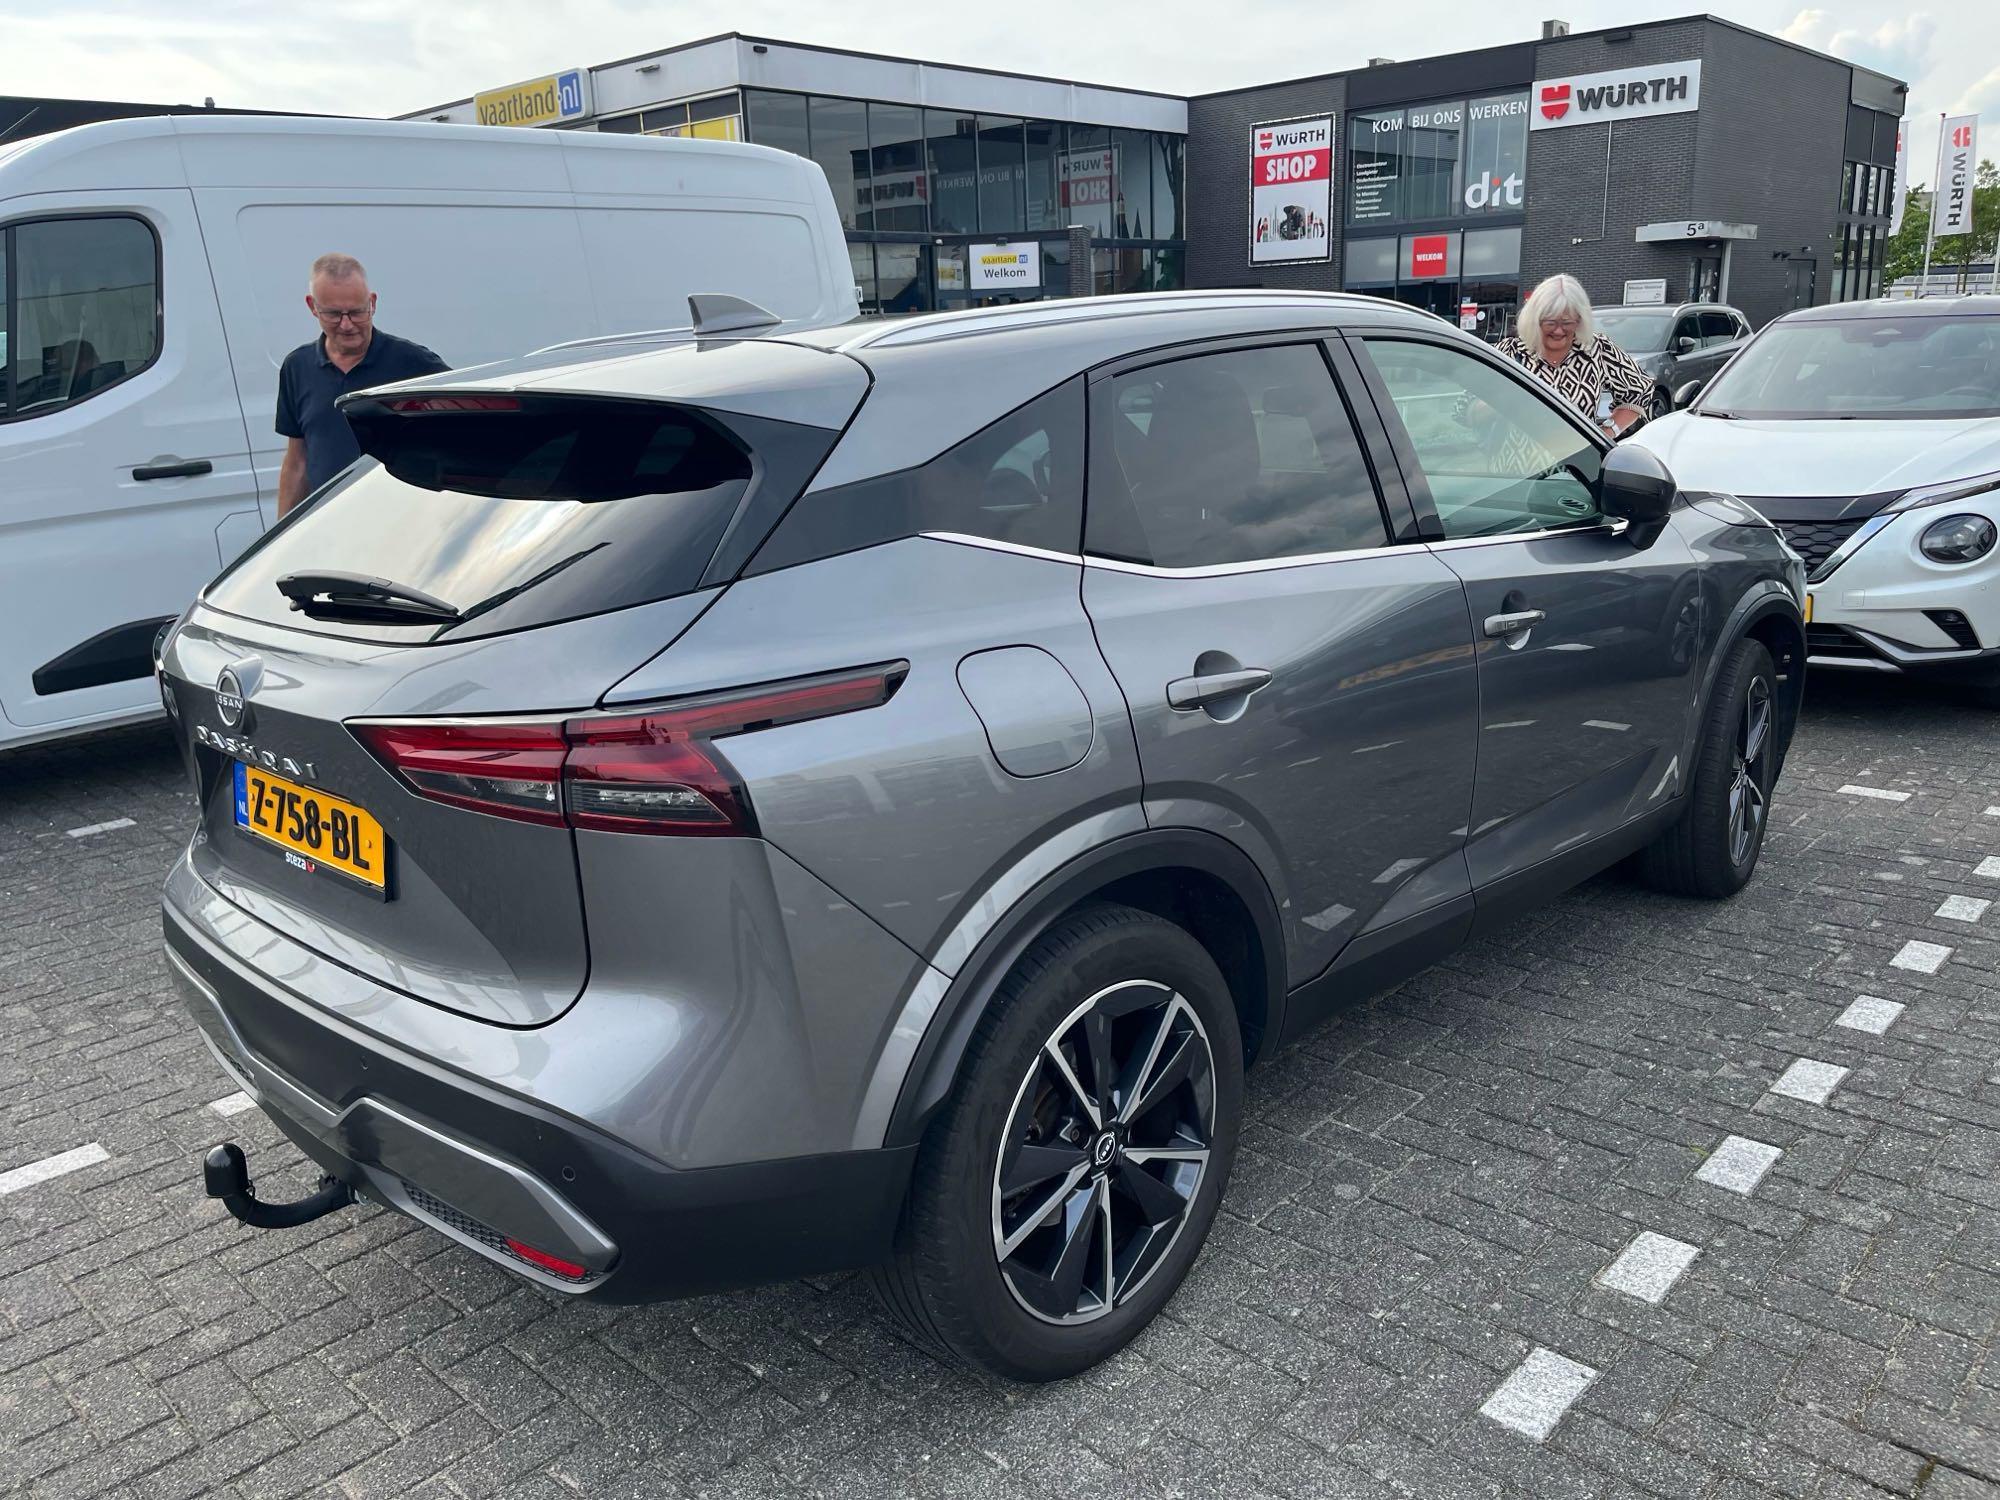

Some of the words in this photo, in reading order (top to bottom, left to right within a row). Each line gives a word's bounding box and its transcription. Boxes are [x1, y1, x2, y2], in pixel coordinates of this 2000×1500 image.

[1577, 76, 1688, 112] WÜRTH
[1372, 117, 1403, 134] KOM
[1412, 115, 1429, 129] BIJ
[1433, 109, 1461, 125] ONS
[1470, 100, 1528, 120] WERKEN
[1276, 128, 1325, 146] WÜRTH
[1266, 154, 1317, 182] SHOP
[1465, 171, 1523, 209] dit
[1947, 152, 1967, 227] WÜRTH
[1416, 252, 1443, 262] WELKOM
[984, 268, 1026, 278] Welkom
[238, 799, 248, 816] NL
[252, 778, 369, 870] Z-758-BL
